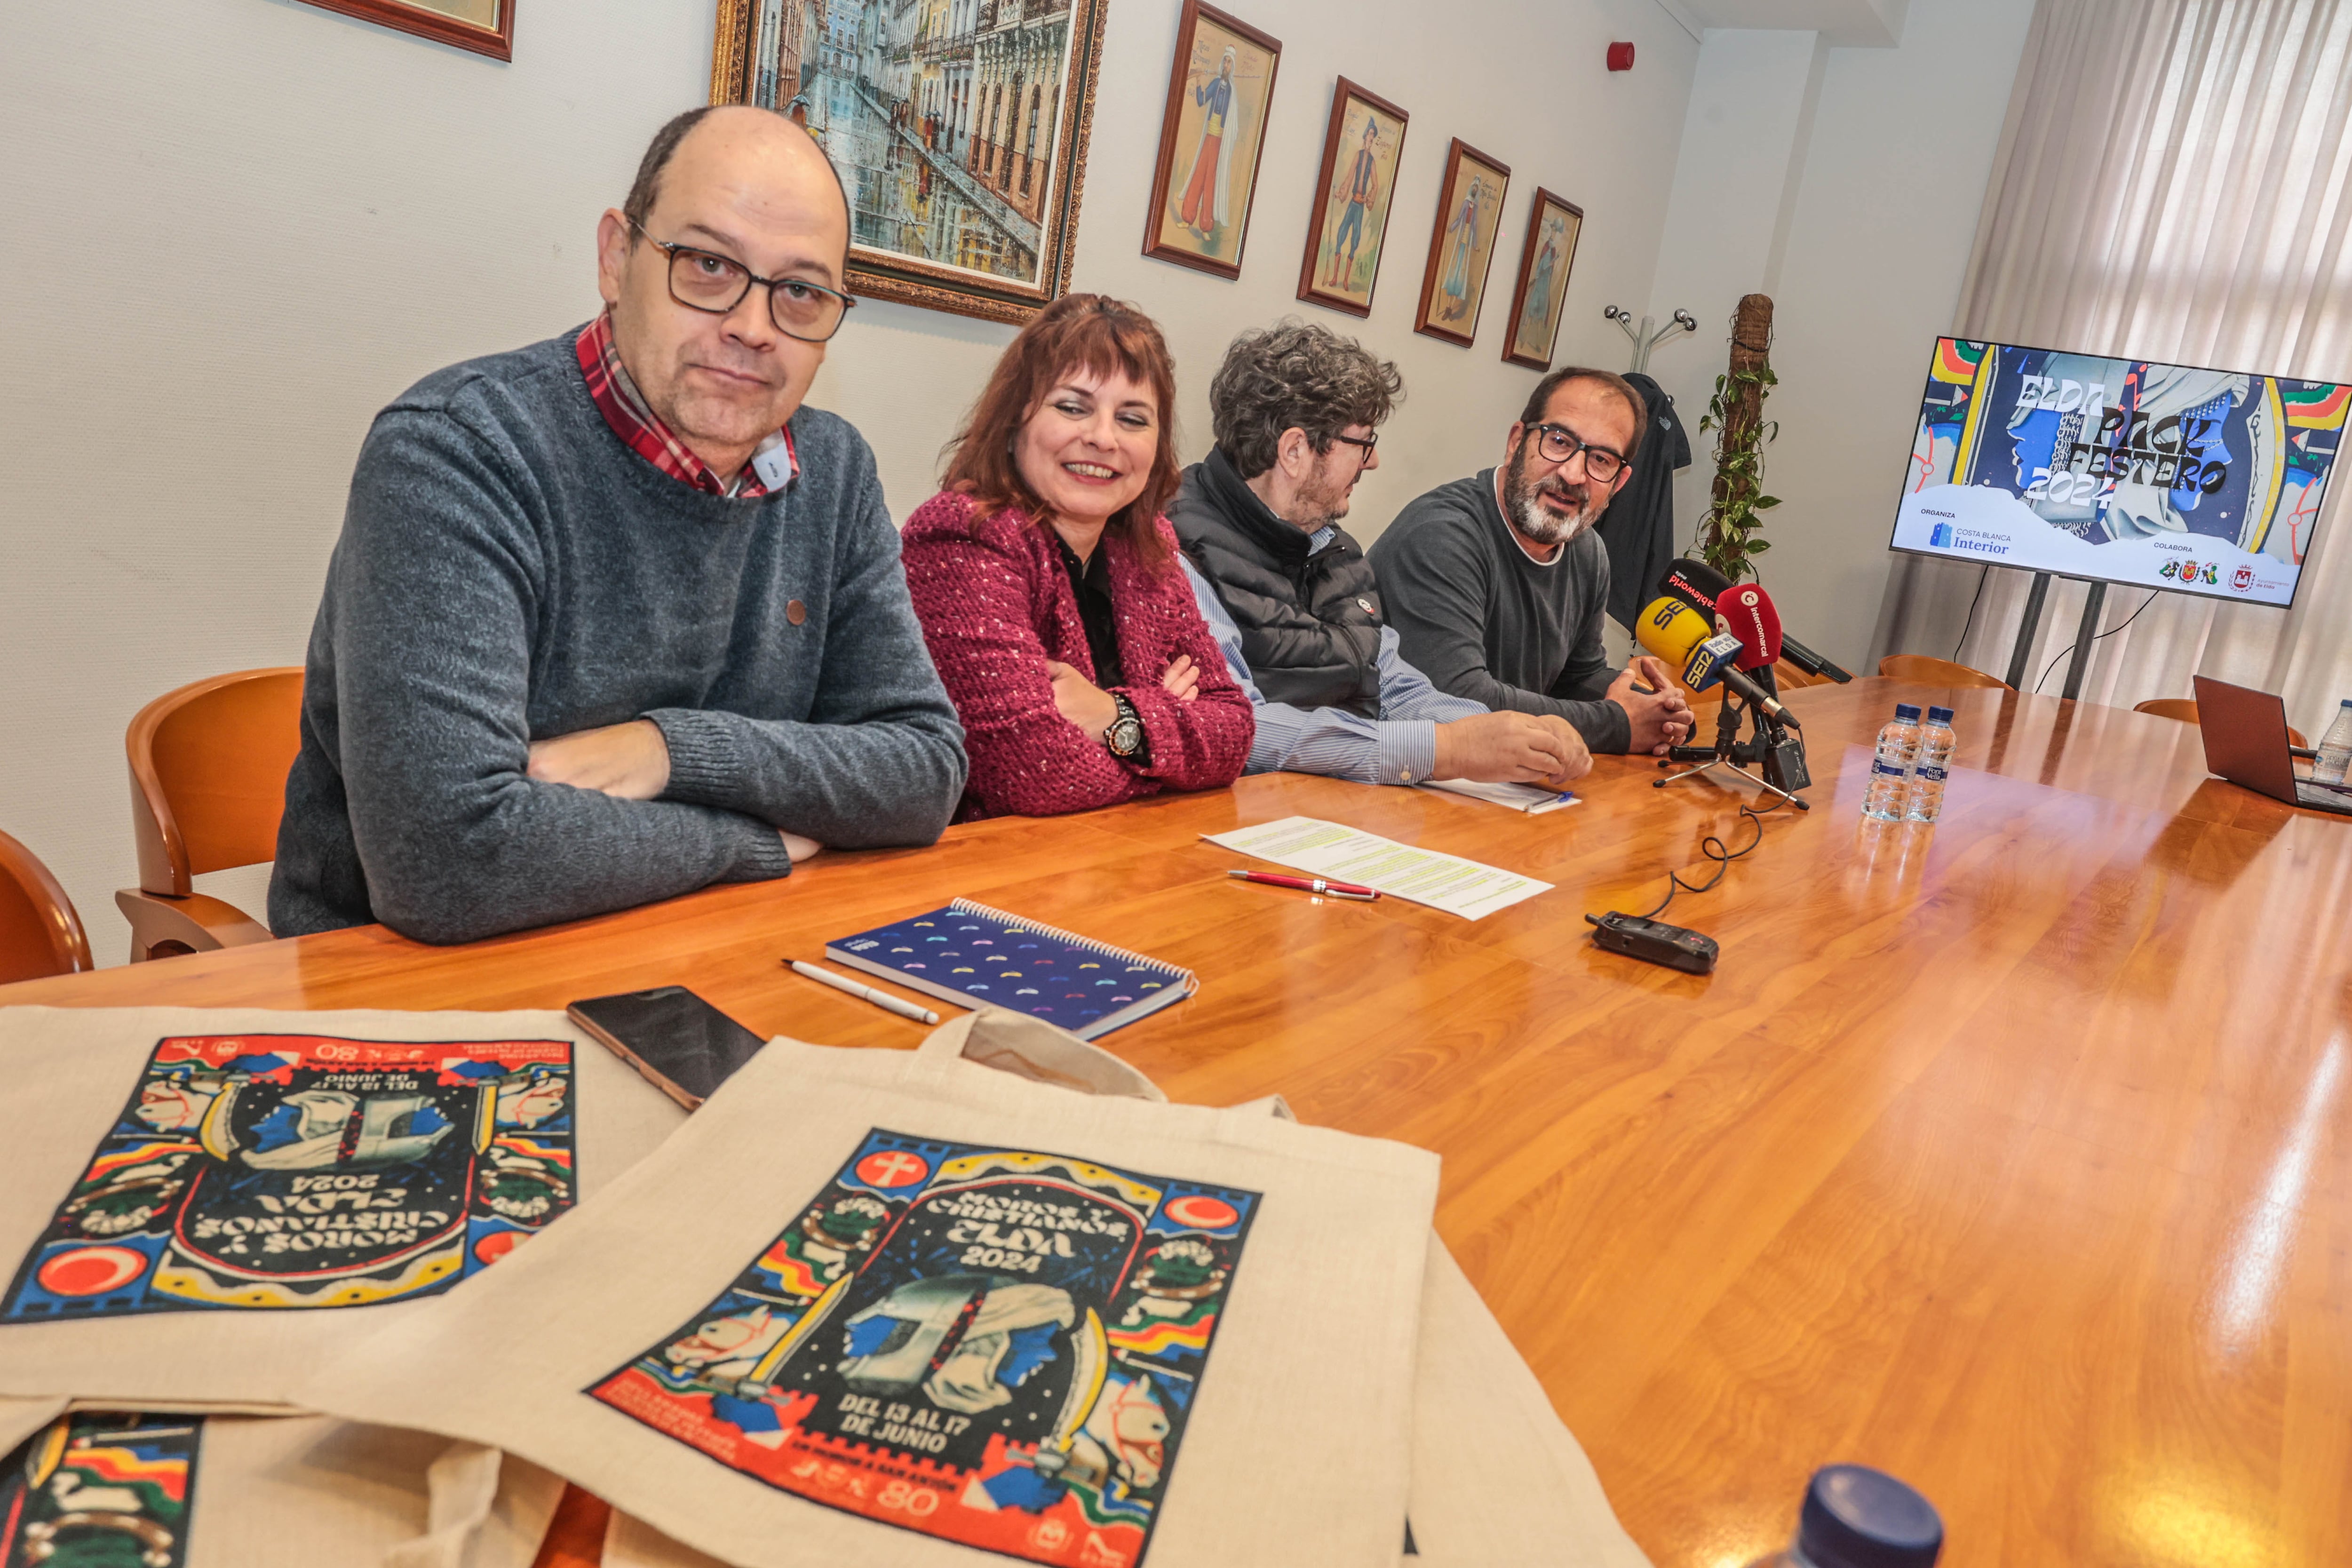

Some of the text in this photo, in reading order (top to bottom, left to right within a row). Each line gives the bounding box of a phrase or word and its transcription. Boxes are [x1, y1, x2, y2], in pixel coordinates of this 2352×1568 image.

[2015, 374, 2105, 417] ELDA
[2094, 407, 2221, 457] PACK
[2068, 442, 2226, 494] FESTERO
[2026, 467, 2114, 509] 2024
[1921, 509, 1955, 518] ORGANIZA
[1954, 537, 2009, 554] Interior
[1956, 528, 2011, 541] COSTA BLANCA
[2153, 542, 2193, 553] COLABORA
[1750, 607, 1769, 657] intercomarcal
[1686, 651, 1715, 689] SER
[316, 1044, 359, 1061] 80
[334, 1082, 357, 1090] AL
[384, 1081, 419, 1090] DEL
[292, 1175, 380, 1193] 2024
[960, 1246, 1042, 1273] 2024
[838, 1393, 972, 1436] DEL 13 AL 17
[840, 1414, 947, 1453] DE JUNIO
[876, 1479, 939, 1517] 80
